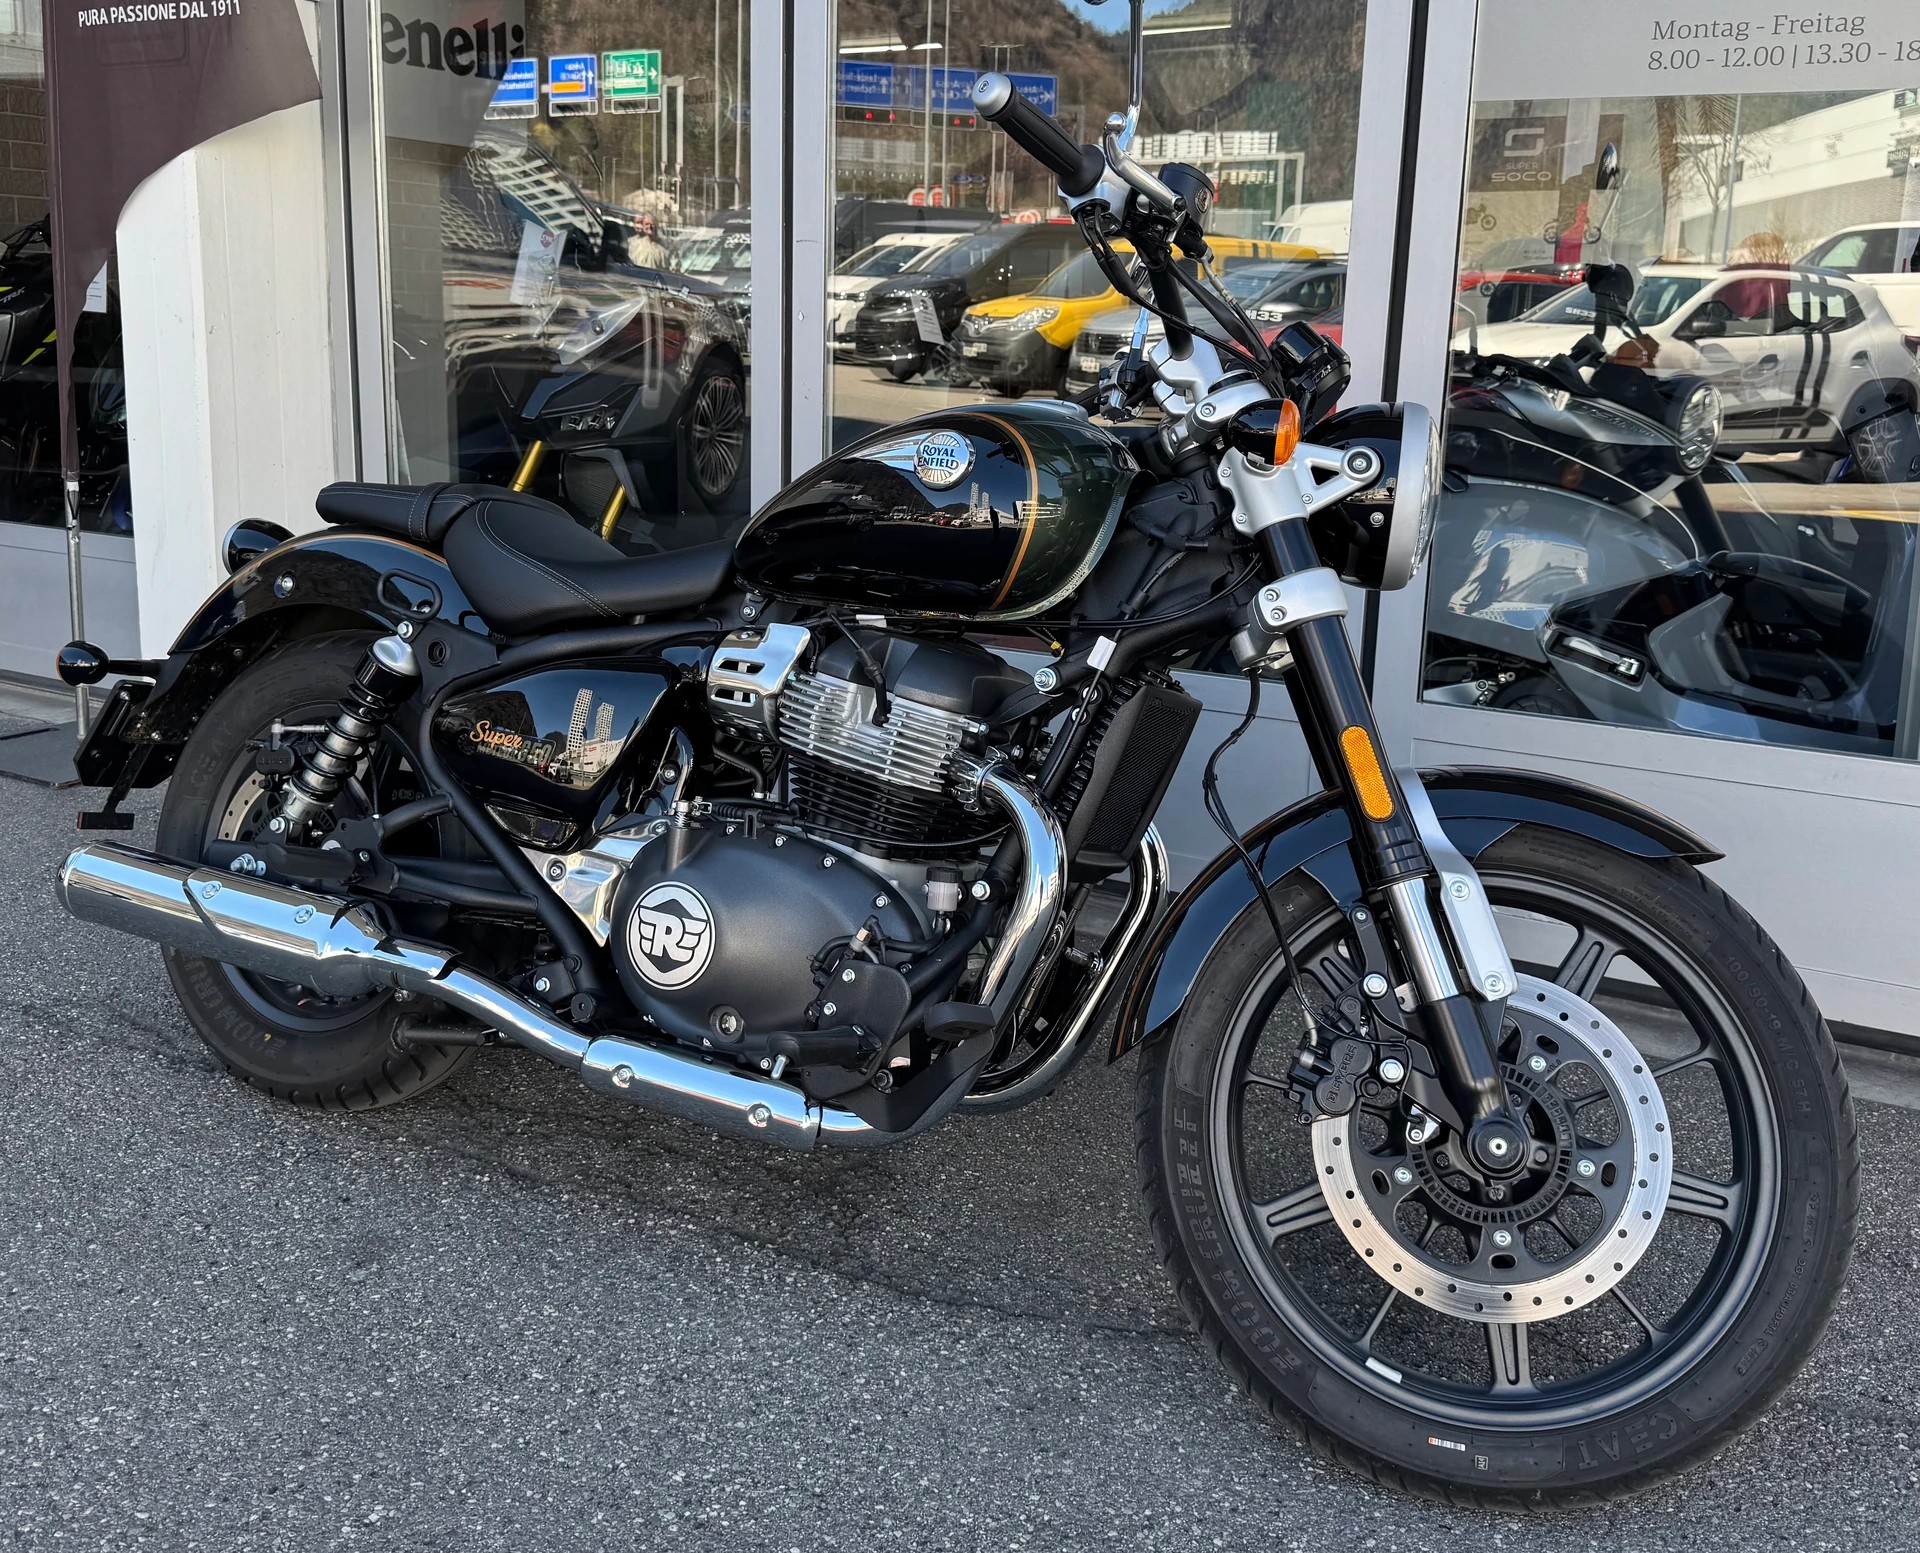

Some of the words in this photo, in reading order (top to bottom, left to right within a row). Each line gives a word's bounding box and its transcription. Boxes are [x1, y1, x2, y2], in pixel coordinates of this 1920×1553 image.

[78, 8, 108, 27] PURA
[110, 3, 177, 23] PASSIONE
[180, 1, 208, 19] DAL
[211, 0, 241, 17] 1911
[1651, 19, 1750, 41] Montag
[1771, 12, 1866, 36] Freitag
[1648, 49, 1700, 70] 8.00
[1721, 45, 1785, 68] 12.00
[1804, 41, 1872, 65] 13.30
[1491, 171, 1552, 182] SOCO
[1506, 162, 1538, 171] SUPER
[917, 456, 960, 470] ENFIELD
[922, 444, 955, 458] ROYAL
[469, 720, 523, 749] Super
[1211, 1269, 1302, 1376] ZOOM
[1578, 1411, 1678, 1469] CEAT
